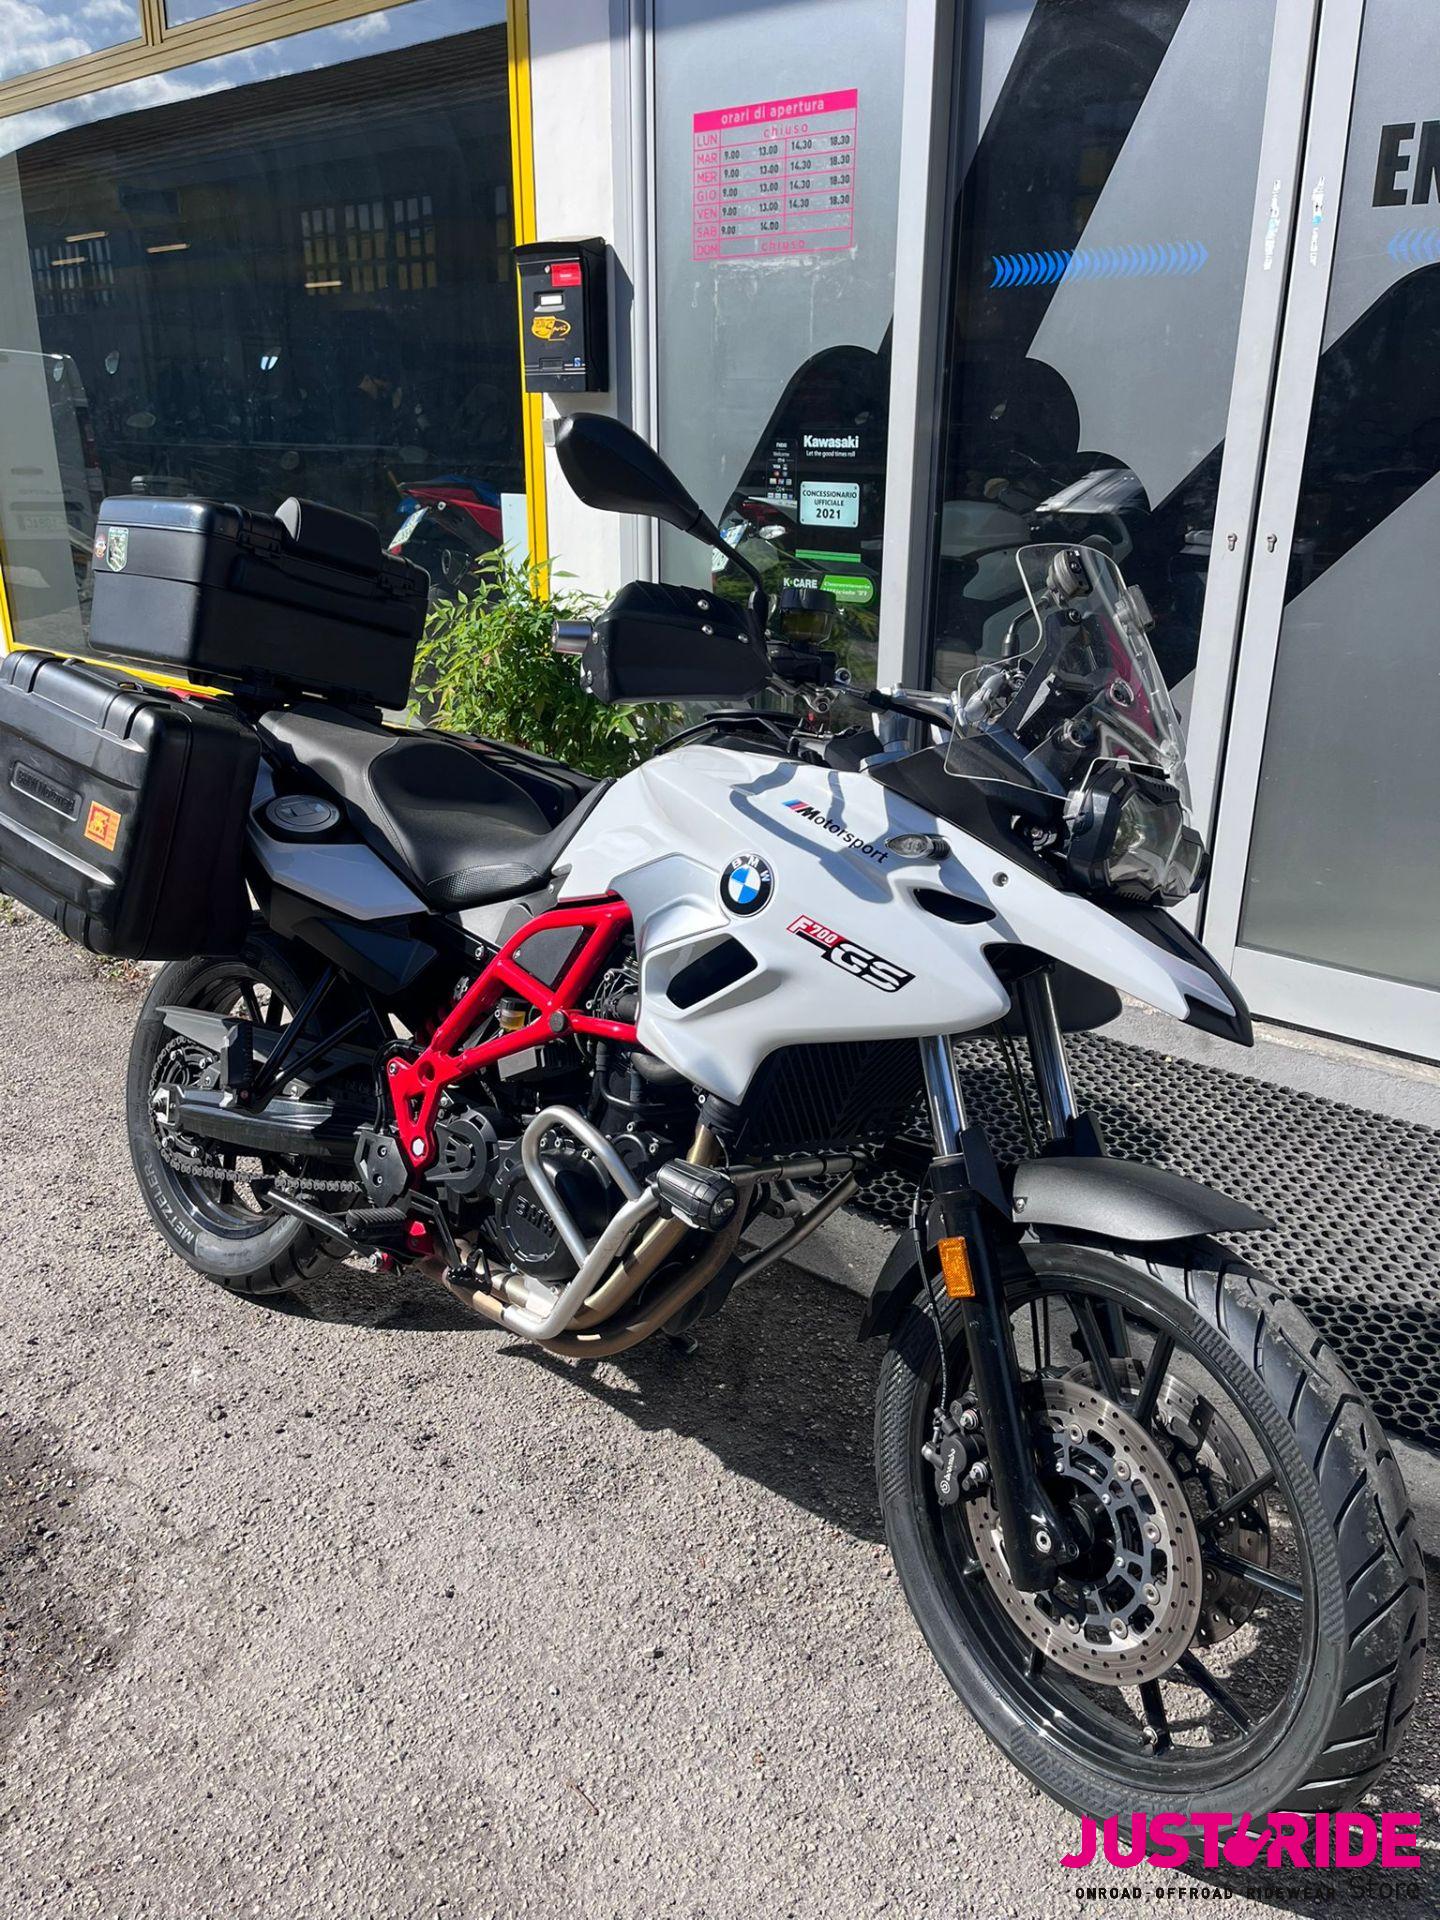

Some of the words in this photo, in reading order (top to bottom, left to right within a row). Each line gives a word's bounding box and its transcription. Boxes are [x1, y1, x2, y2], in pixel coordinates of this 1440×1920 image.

[721, 111, 749, 125] orari
[754, 107, 766, 120] di
[770, 98, 825, 118] apertura
[697, 134, 718, 147] LUN
[763, 123, 809, 138] chiuso
[697, 153, 718, 165] MAR
[724, 150, 740, 160] 9.00
[758, 145, 778, 157] 13.00
[791, 139, 812, 151] 14.30
[830, 135, 851, 146] 18.30
[697, 171, 718, 183] MER
[724, 169, 740, 179] 9.00
[759, 164, 779, 175] 13.00
[790, 160, 812, 171] 14.30
[830, 154, 851, 166] 18.30
[697, 190, 717, 202] GIO
[722, 188, 738, 198] 9.00
[759, 182, 779, 193] 13.00
[789, 179, 811, 190] 14.30
[830, 174, 850, 186] 18.30
[697, 207, 717, 219] VEN
[722, 207, 737, 216] 9.00
[759, 202, 778, 212] 13.00
[789, 199, 810, 209] 14.30
[830, 195, 850, 205] 18.30
[697, 225, 717, 238] SAB
[721, 226, 736, 235] 9.00
[760, 222, 779, 231] 14.00
[697, 244, 718, 256] DOM
[761, 239, 806, 251] chiuso
[803, 434, 860, 449] Kawasaki
[802, 489, 858, 499] CONCESSIONARIO
[816, 508, 841, 520] 2021
[797, 806, 888, 864] Motorsport
[731, 853, 771, 882] BMW
[830, 943, 908, 992] GS
[145, 1164, 195, 1244] METZELER
